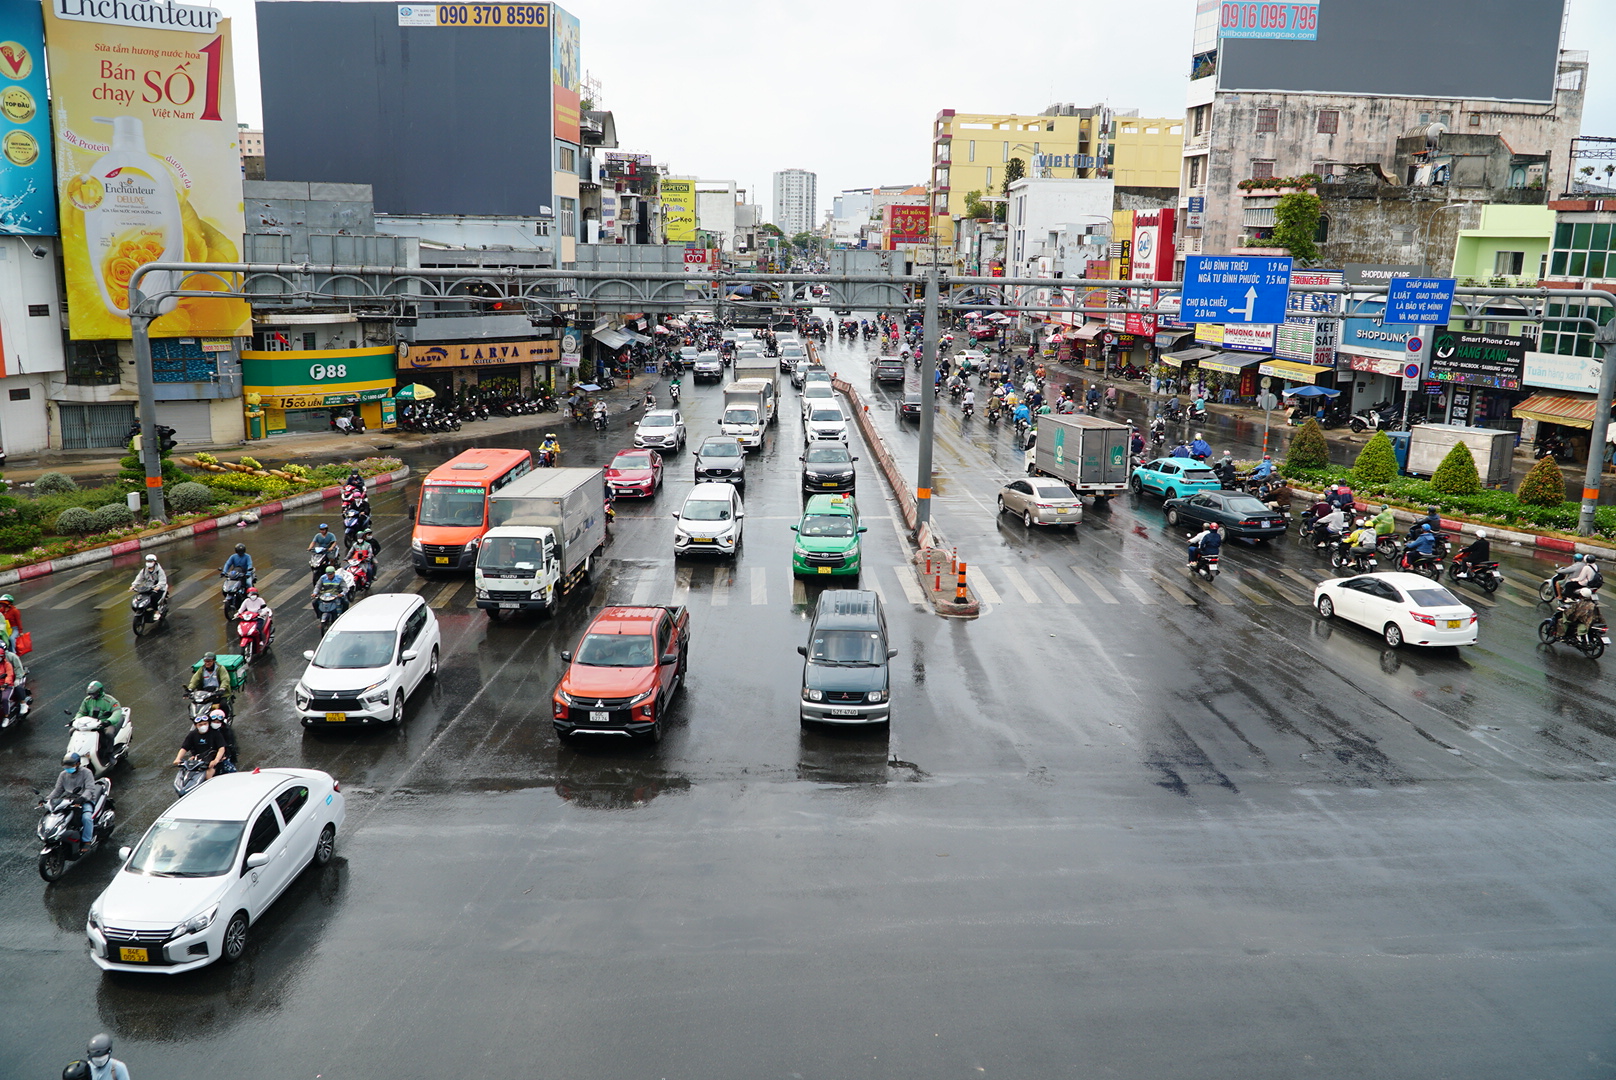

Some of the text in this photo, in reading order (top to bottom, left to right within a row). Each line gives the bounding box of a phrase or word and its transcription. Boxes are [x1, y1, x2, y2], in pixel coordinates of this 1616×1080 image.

[439, 6, 468, 24] 090
[473, 6, 502, 24] 370
[506, 6, 545, 24] 8596
[1221, 4, 1316, 30] 0916 095 795
[1220, 30, 1315, 39] billboardquangcao.com
[94, 43, 200, 60] Sữa tắm hương nước hoa
[100, 60, 136, 81] Bán
[199, 34, 224, 121] 1
[92, 62, 195, 107] chạy SỐ
[152, 108, 195, 120] Việt Nam
[63, 130, 110, 152] Silk Protein
[166, 155, 192, 190] dưỡng da
[105, 183, 155, 195] Enchanteur
[117, 196, 145, 205] DELUXE
[1214, 260, 1228, 270] BÌNH
[1230, 260, 1248, 272] TRIỆU
[1277, 263, 1288, 272] Km
[1198, 273, 1211, 282] NGÃ
[1213, 274, 1221, 283] TƯ
[1222, 273, 1238, 283] BÌNH
[1238, 273, 1260, 284] PHƯỚC
[1276, 276, 1286, 284] Km
[1293, 274, 1330, 285] TRUNG TÂM
[1361, 270, 1392, 279] SHOPDUNK
[1423, 281, 1439, 289] HÀNH
[1393, 292, 1411, 300] LUẬT
[1431, 291, 1449, 300] THÔNG
[1186, 298, 1199, 308] CHỢ
[1200, 296, 1208, 307] BÀ
[1418, 302, 1426, 311] VỆ
[1421, 312, 1438, 321] NGƯỜI
[1317, 321, 1335, 332] KÉT
[1316, 332, 1334, 346] SẮT
[1356, 330, 1405, 343] SHOPDUNK
[460, 346, 520, 360] LARVA
[1314, 352, 1332, 364] 30%
[1457, 344, 1510, 362] HÀNG XANH
[310, 364, 346, 380] F88
[1548, 368, 1564, 380] hàng
[1566, 371, 1582, 380] xanh
[280, 398, 294, 408] 15
